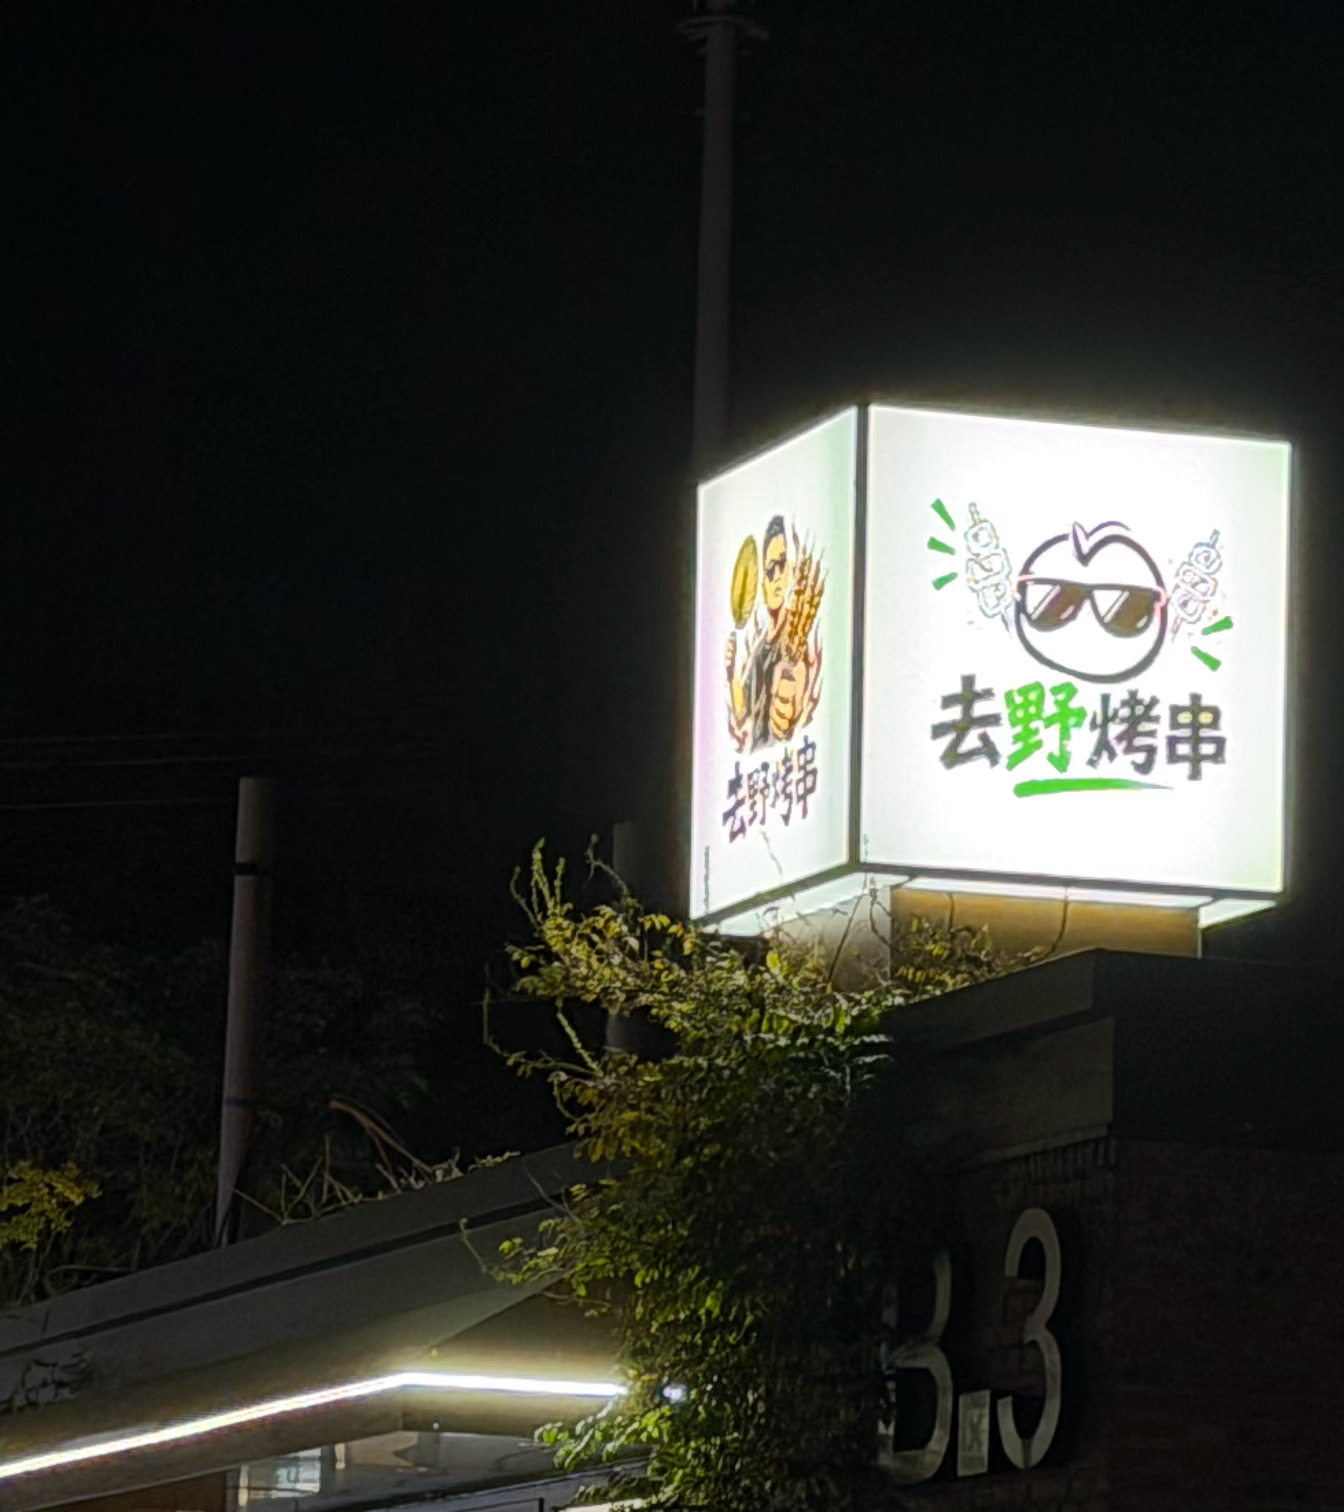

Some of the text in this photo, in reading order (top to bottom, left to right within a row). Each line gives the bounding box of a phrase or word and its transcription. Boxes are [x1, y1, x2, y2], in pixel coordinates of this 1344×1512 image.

[931, 674, 1227, 781] 去野烤串
[721, 734, 818, 844] 去野烤串
